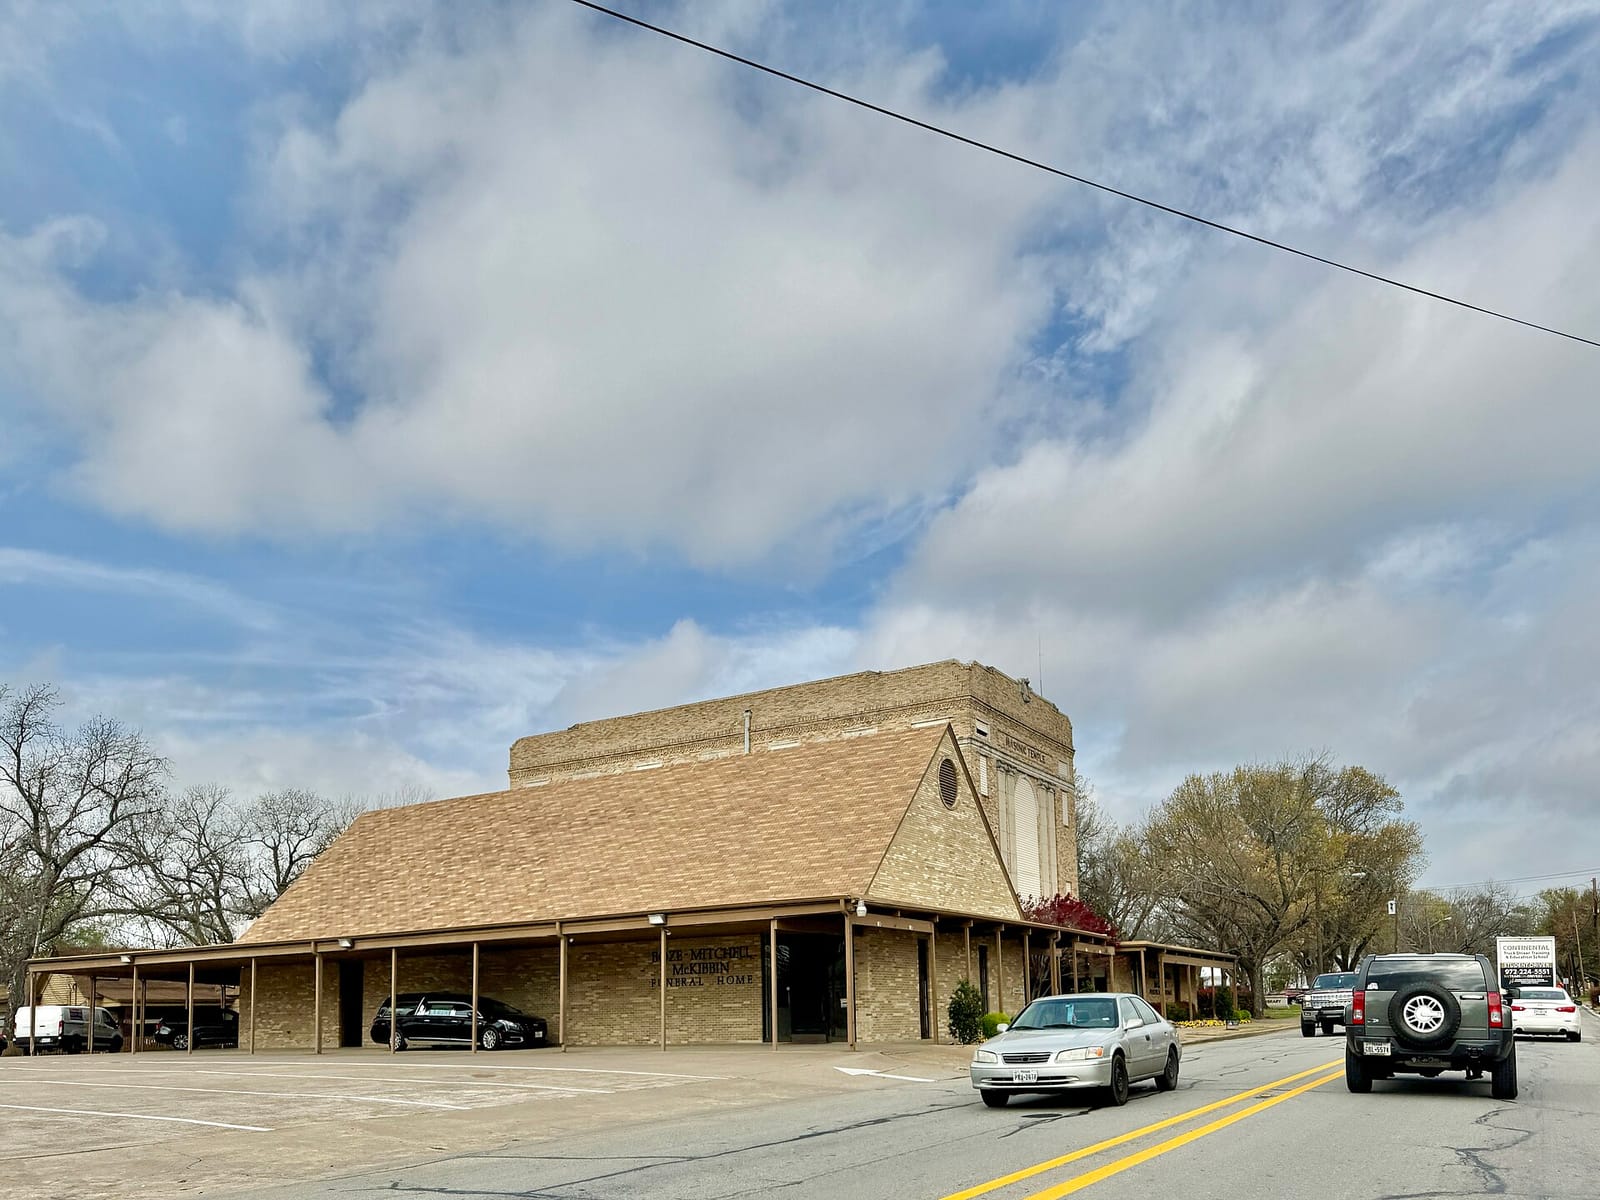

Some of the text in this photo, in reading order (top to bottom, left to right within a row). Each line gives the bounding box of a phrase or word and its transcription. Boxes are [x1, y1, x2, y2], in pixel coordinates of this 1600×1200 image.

[1027, 747, 1046, 764] TEMPLE
[672, 961, 730, 975] McKIBBIN
[717, 975, 753, 985] HOME
